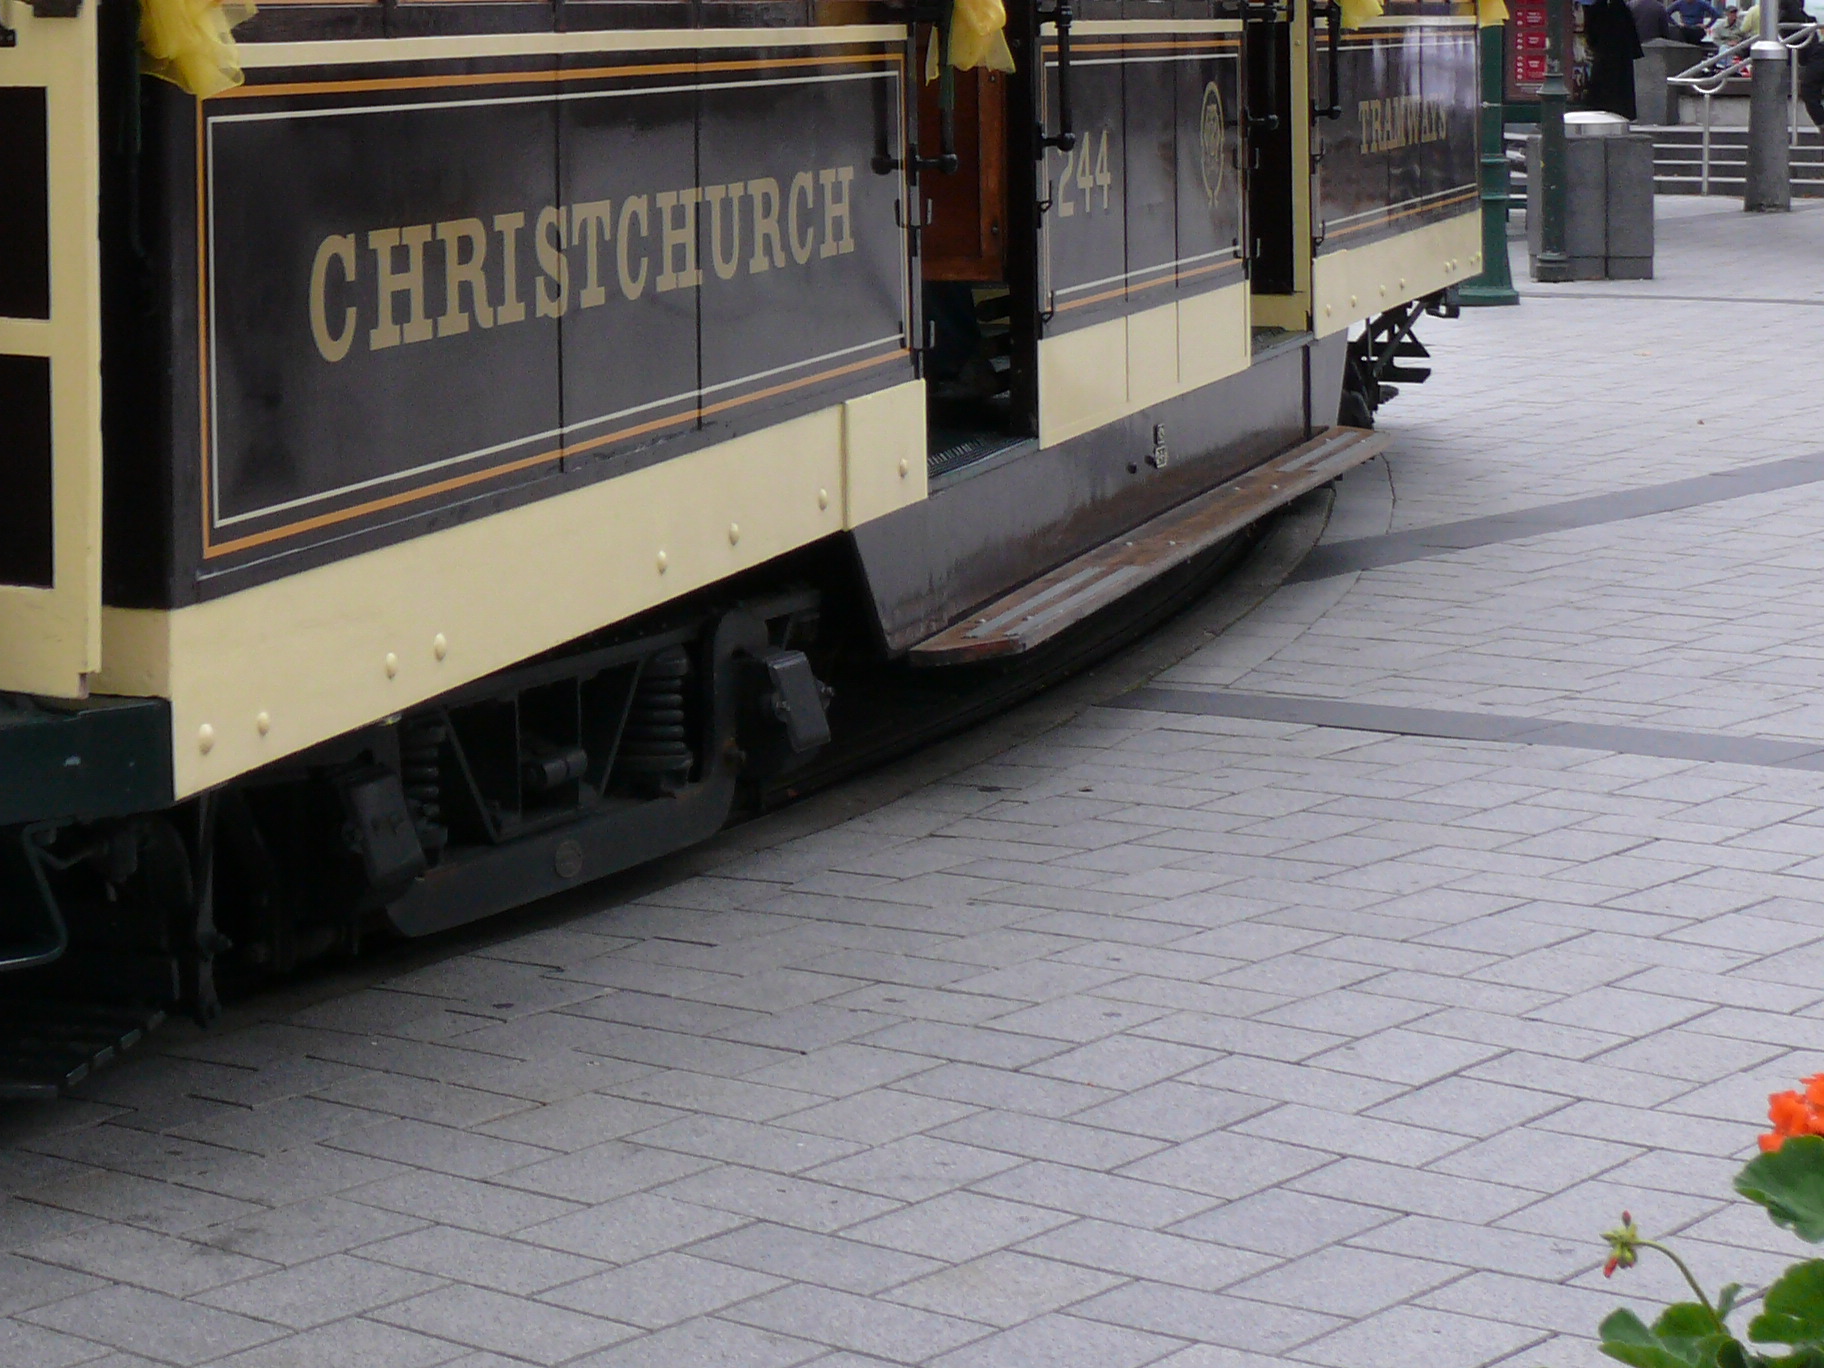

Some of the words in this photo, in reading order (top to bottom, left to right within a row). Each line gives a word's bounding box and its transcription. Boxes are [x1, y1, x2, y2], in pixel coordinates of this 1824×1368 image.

[1358, 93, 1447, 155] TRAMWAYS
[1057, 128, 1112, 218] 244
[308, 164, 856, 363] CHRISTCHURCH
